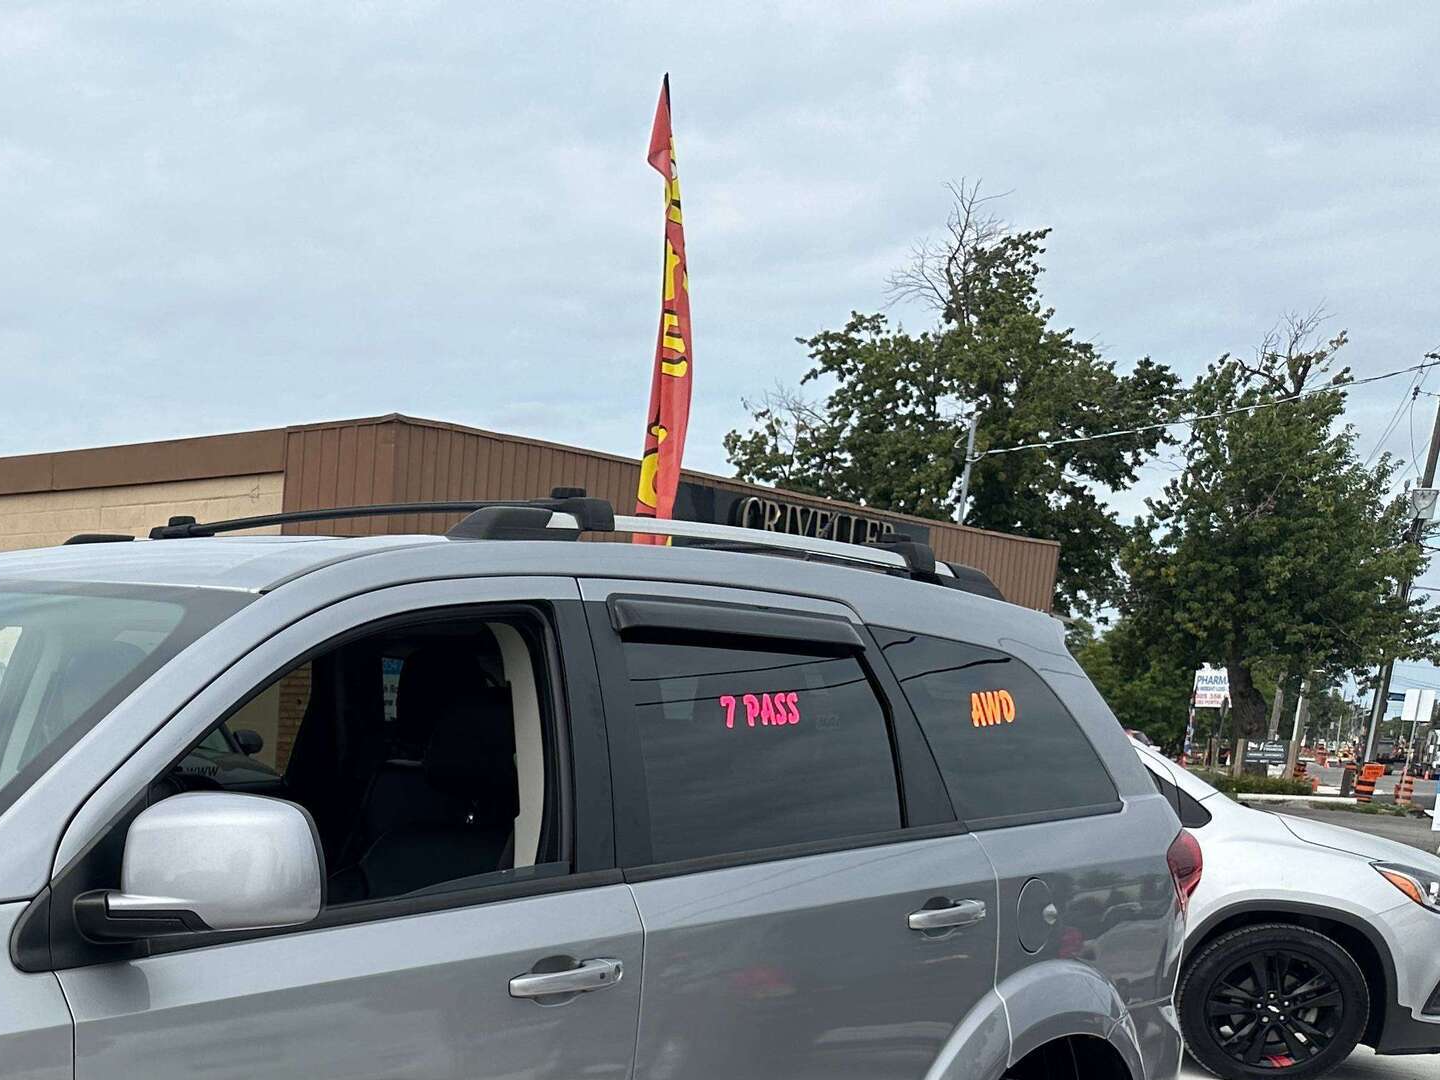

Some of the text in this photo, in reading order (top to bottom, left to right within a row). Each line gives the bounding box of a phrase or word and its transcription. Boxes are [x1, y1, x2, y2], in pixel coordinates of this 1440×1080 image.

[720, 692, 800, 729] 7 PASS
[971, 690, 1016, 728] AWD
